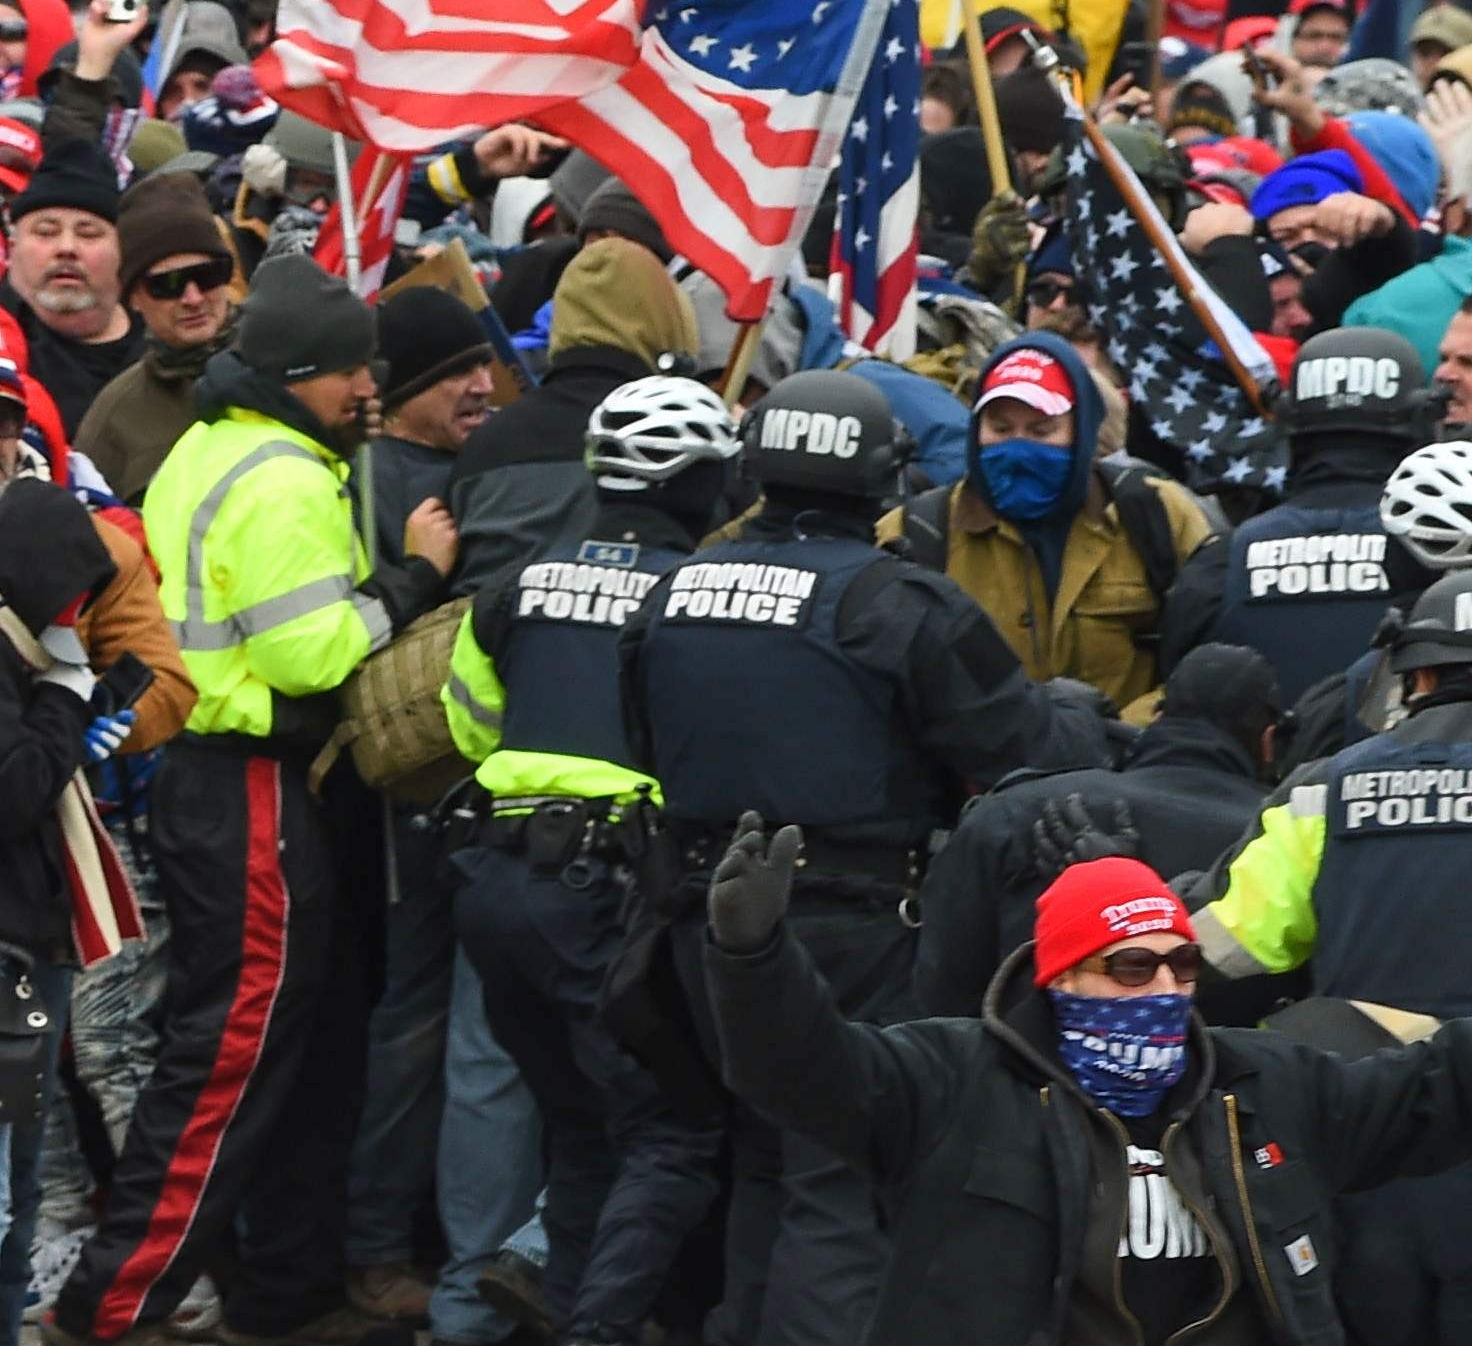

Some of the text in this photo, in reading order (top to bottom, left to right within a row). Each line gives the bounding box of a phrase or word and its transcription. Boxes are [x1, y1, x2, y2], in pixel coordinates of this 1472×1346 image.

[1296, 356, 1402, 401] MPDC
[760, 408, 863, 459] MPDC
[669, 561, 818, 600] METROPOLITAN
[663, 589, 803, 627] POLICE
